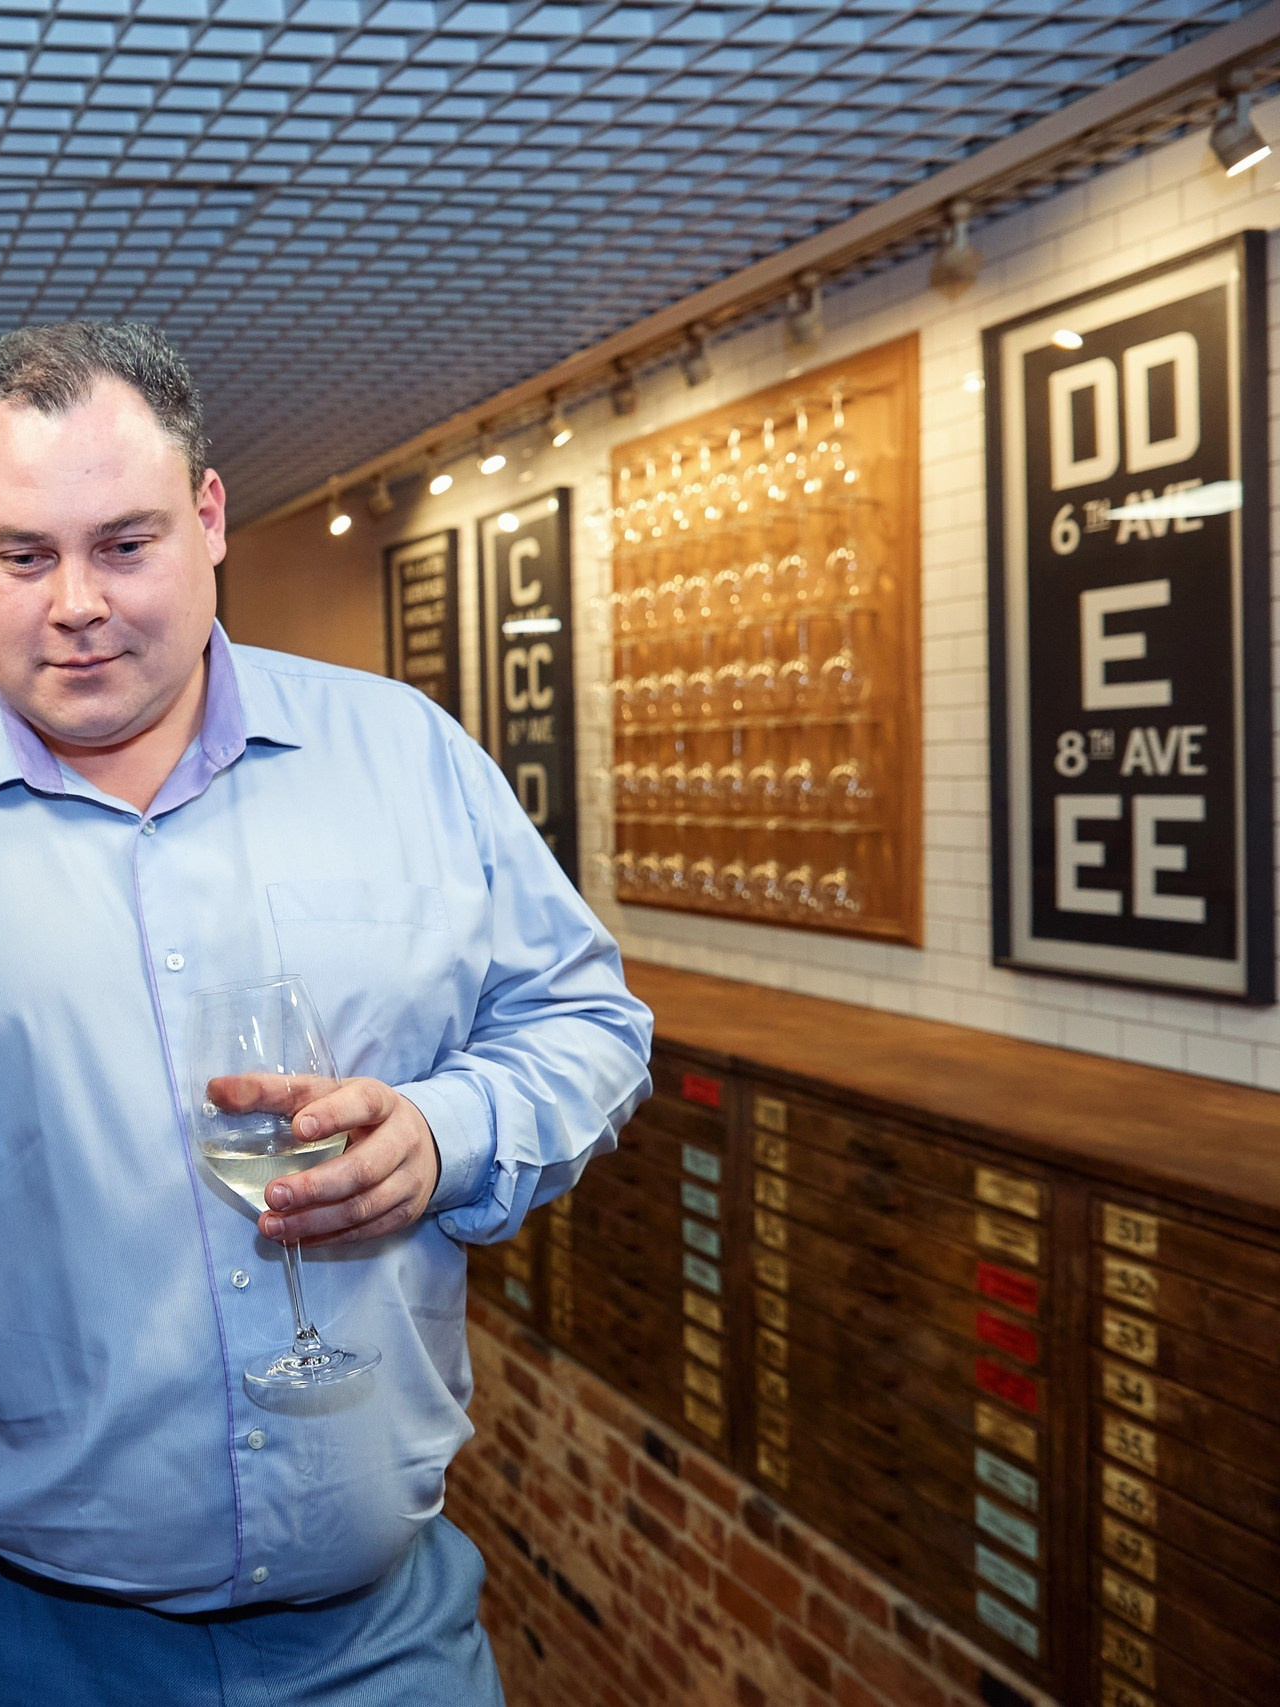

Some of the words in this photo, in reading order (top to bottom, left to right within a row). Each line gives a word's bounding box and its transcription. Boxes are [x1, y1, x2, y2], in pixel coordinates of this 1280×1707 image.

[1049, 331, 1201, 491] DD
[1116, 478, 1205, 545] AVE
[509, 536, 542, 607] C
[504, 642, 553, 714] CC
[1080, 578, 1172, 711] E
[1121, 725, 1208, 777] AVE
[1055, 793, 1207, 924] EE
